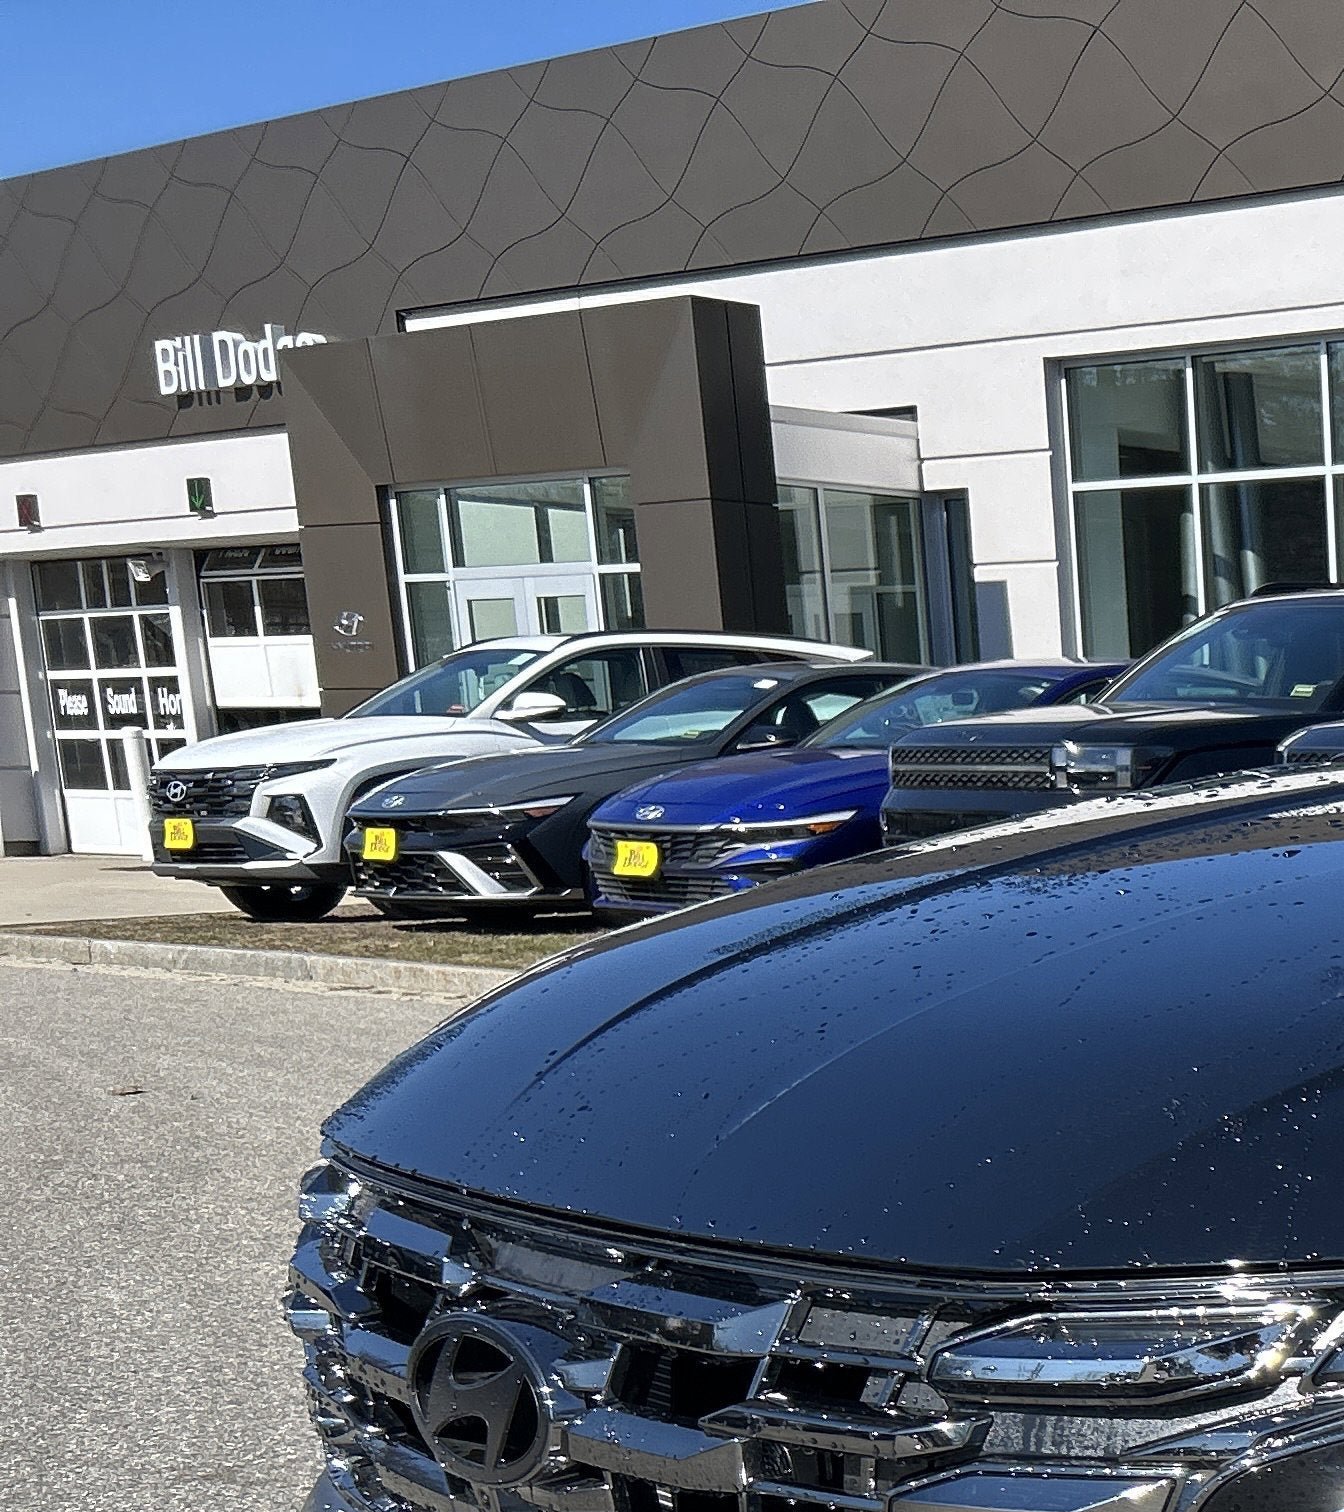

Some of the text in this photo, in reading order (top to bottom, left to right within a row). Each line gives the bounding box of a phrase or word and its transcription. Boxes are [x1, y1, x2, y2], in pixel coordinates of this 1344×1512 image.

[155, 323, 328, 395] Bill Dod
[57, 687, 182, 716] Please Sound Hor
